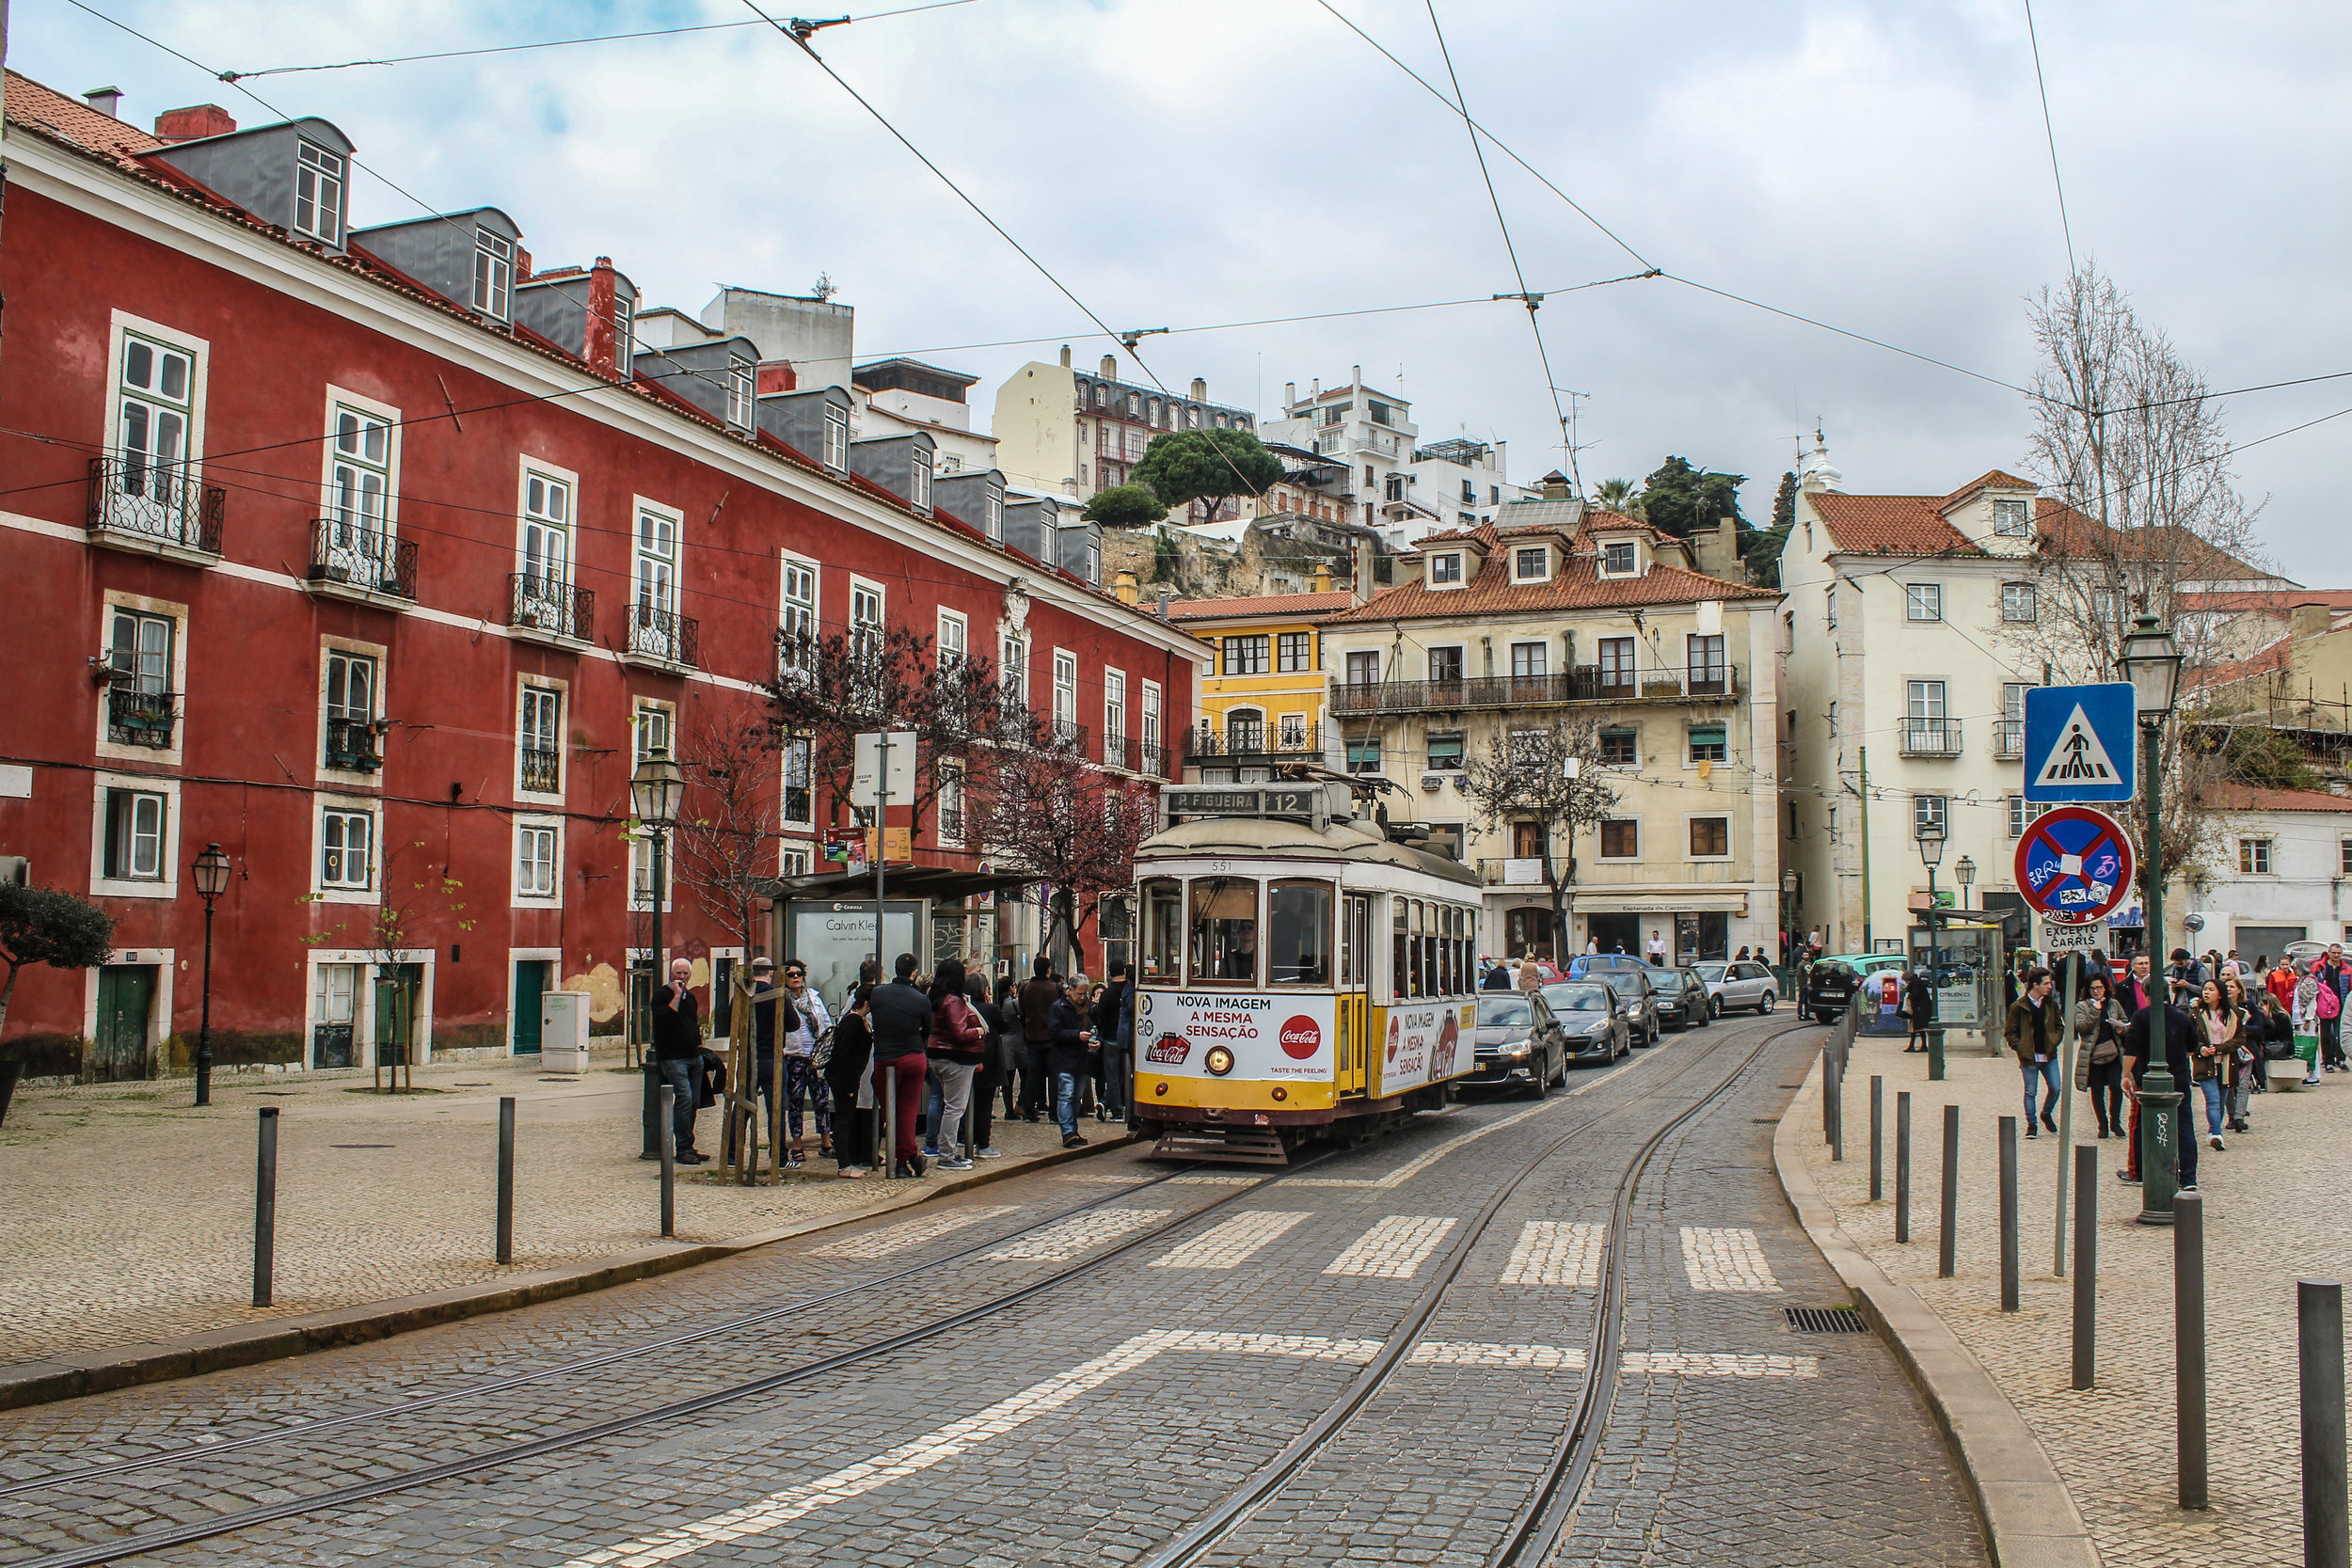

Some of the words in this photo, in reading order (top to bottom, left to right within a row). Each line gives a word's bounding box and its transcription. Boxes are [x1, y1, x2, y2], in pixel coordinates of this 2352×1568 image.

[1179, 794, 1187, 806] P.
[1193, 794, 1254, 808] FIGUEIRA
[1275, 794, 1297, 812] 12
[1212, 862, 1232, 872] 551
[826, 919, 857, 930] Calvin
[2045, 924, 2099, 937] EXCEPTO
[2051, 936, 2096, 948] CARRIS
[1176, 996, 1211, 1008] NOVA
[1216, 997, 1271, 1010] IMAGEM
[1190, 1011, 1200, 1022] A
[1203, 1011, 1253, 1023] MESMA
[1185, 1024, 1259, 1040] SENSAÇÃO
[1280, 1029, 1319, 1044] Coca-Cola
